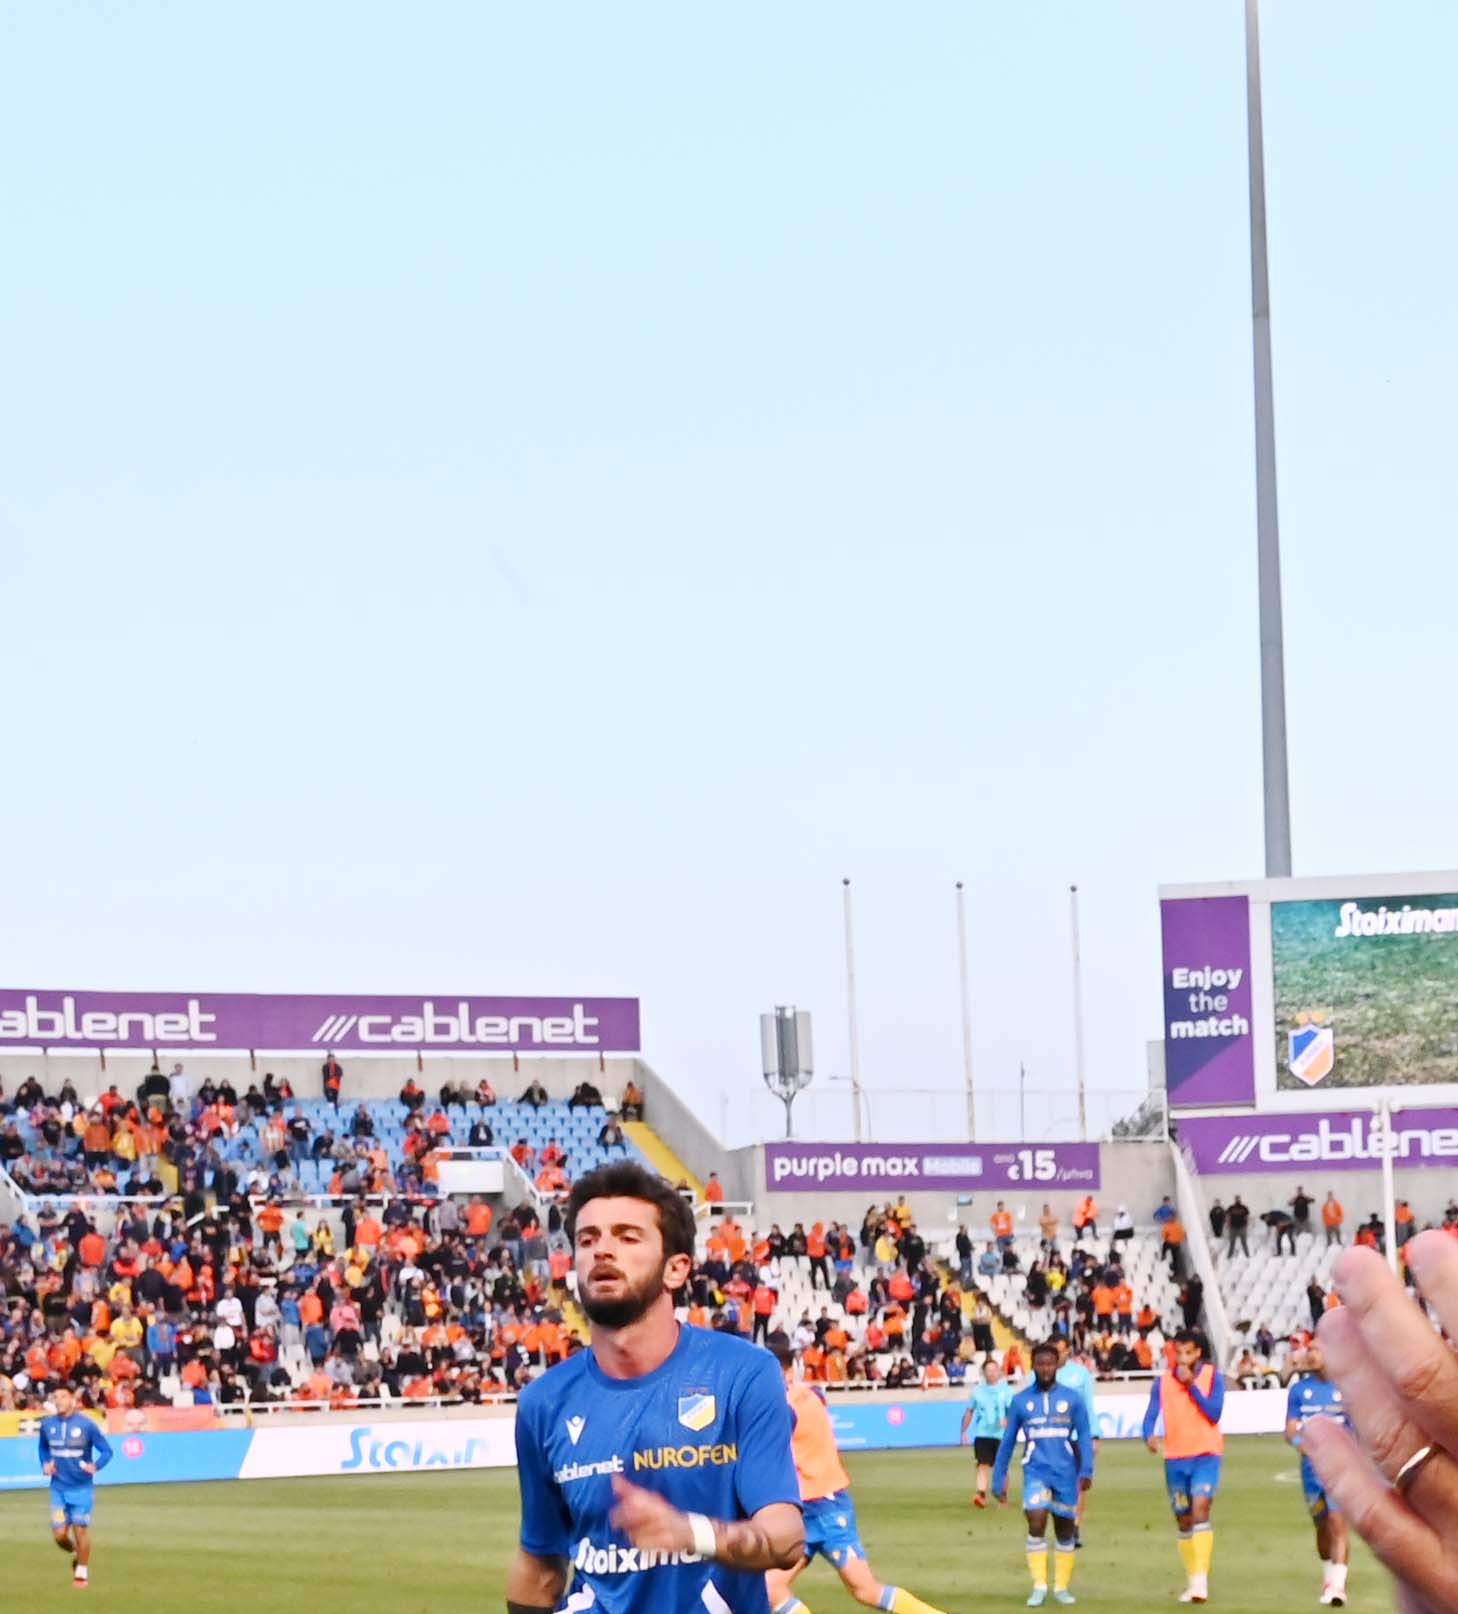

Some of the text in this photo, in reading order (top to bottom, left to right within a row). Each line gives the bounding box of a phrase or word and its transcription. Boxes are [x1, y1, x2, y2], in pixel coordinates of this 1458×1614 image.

[1172, 965, 1243, 993] Enjoy
[1189, 991, 1228, 1013] the
[358, 1002, 600, 1044] cablenet
[1170, 1015, 1249, 1040] match
[773, 1152, 859, 1182] purple
[861, 1157, 920, 1177] max
[634, 1443, 738, 1471] NUROFEN
